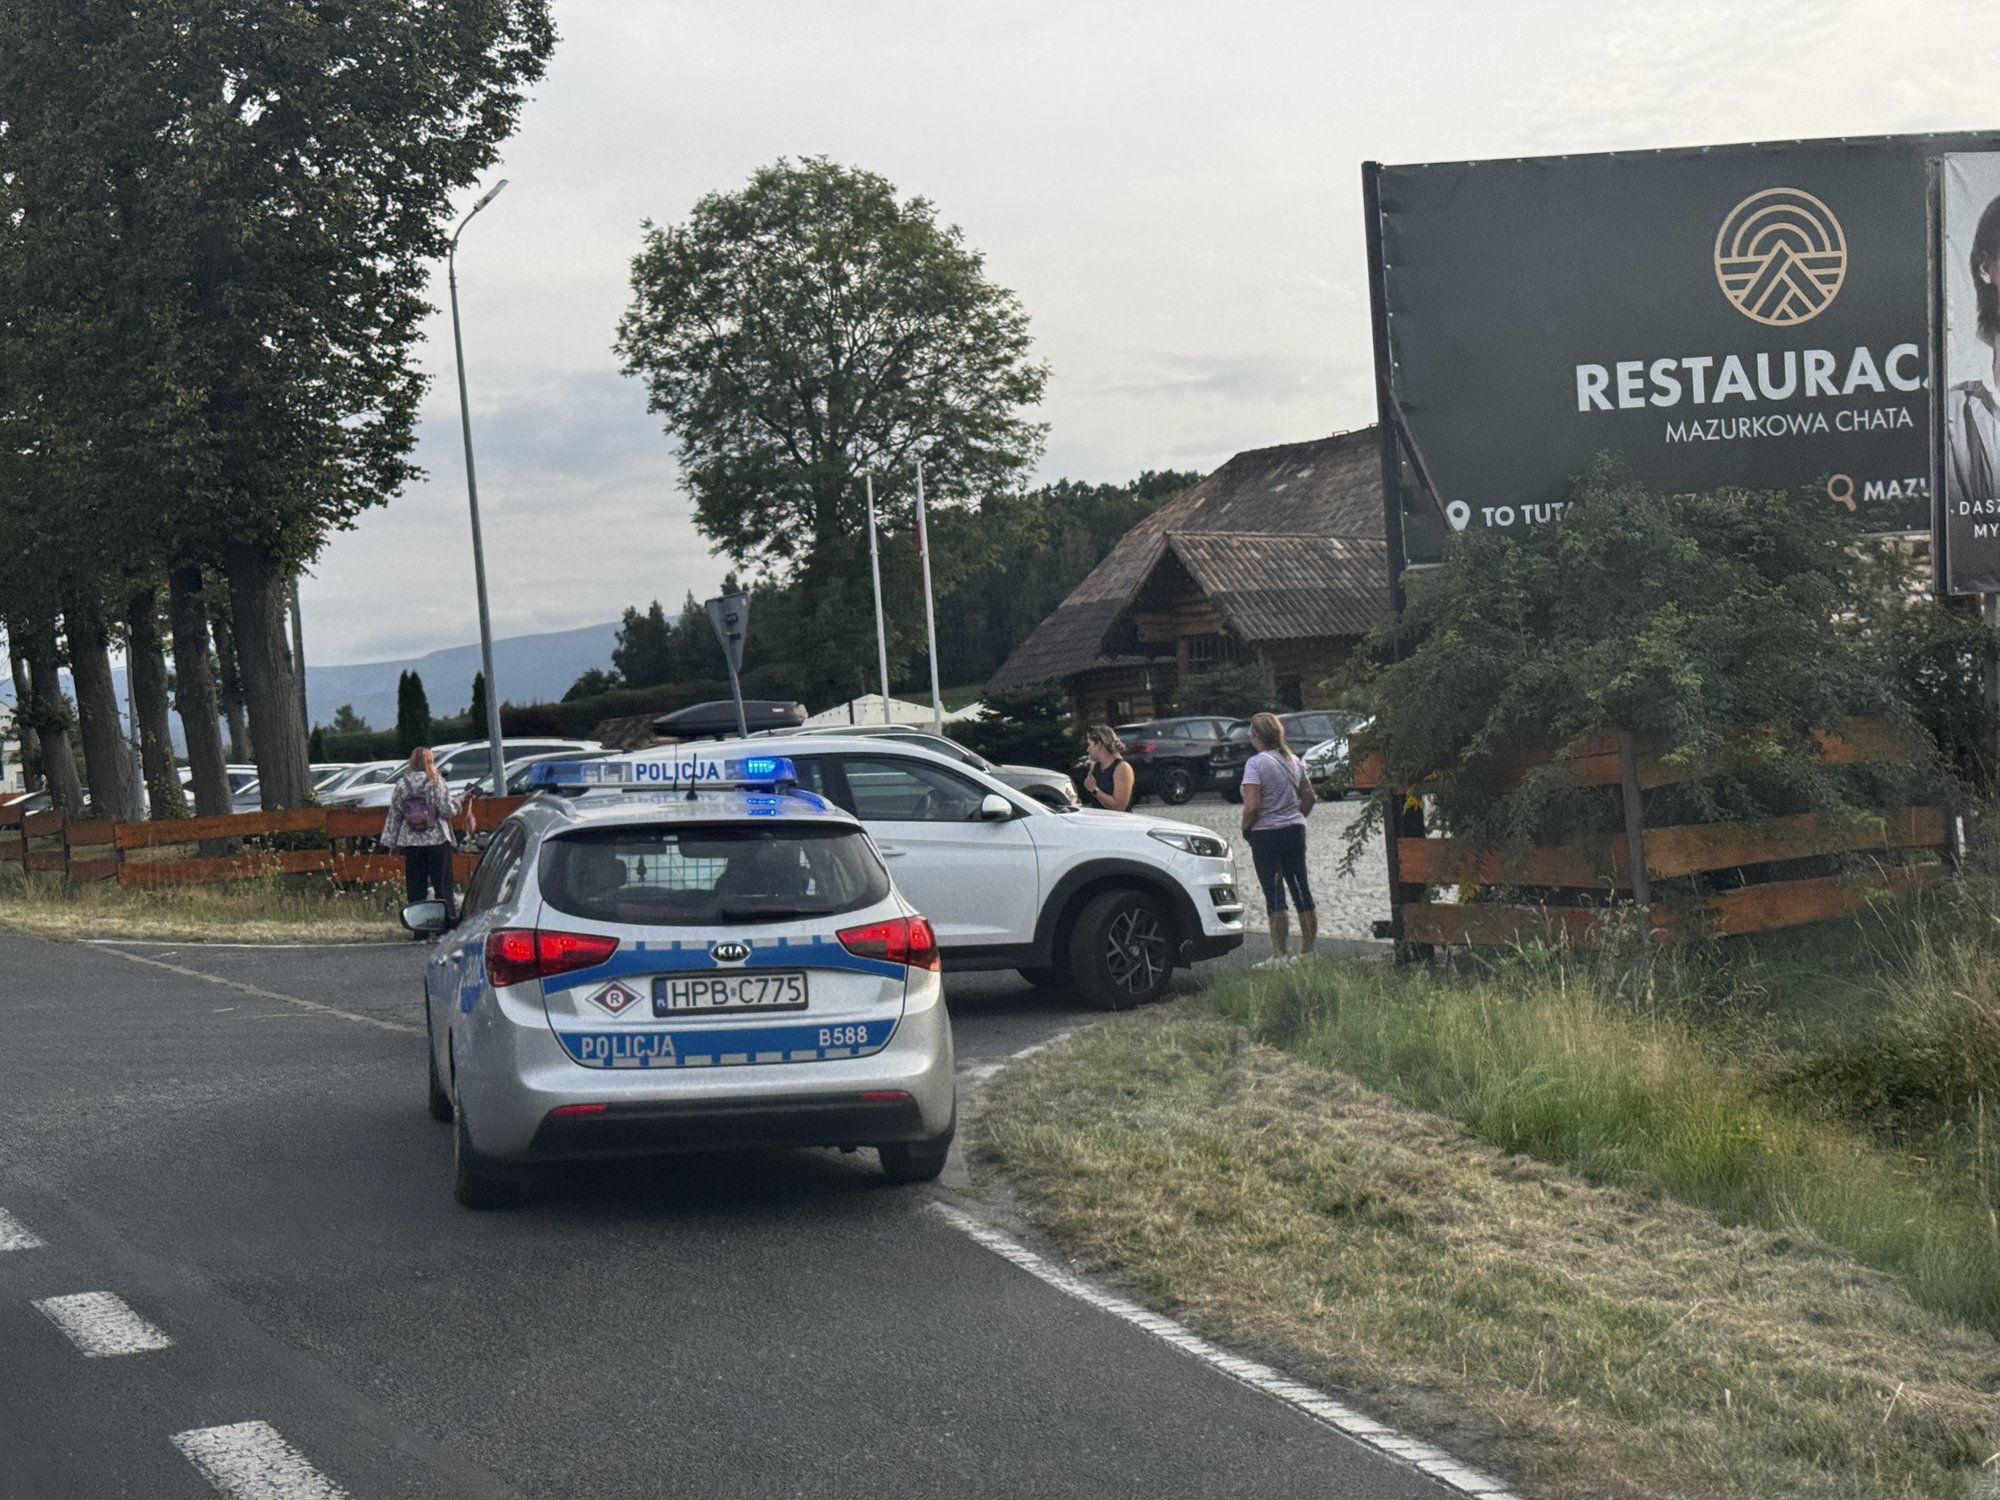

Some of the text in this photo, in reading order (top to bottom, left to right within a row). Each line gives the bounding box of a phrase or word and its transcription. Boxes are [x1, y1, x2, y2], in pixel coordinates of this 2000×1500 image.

[1576, 343, 1930, 412] RESTAURAC
[1665, 406, 1914, 443] MAZURKOWA CHATA
[1481, 505, 1515, 527] TO
[635, 761, 720, 782] POLICJA
[717, 945, 743, 958] KIA
[609, 992, 620, 1005] R
[671, 976, 801, 1008] HPB C775
[581, 1025, 868, 1059] POLICJA B588
